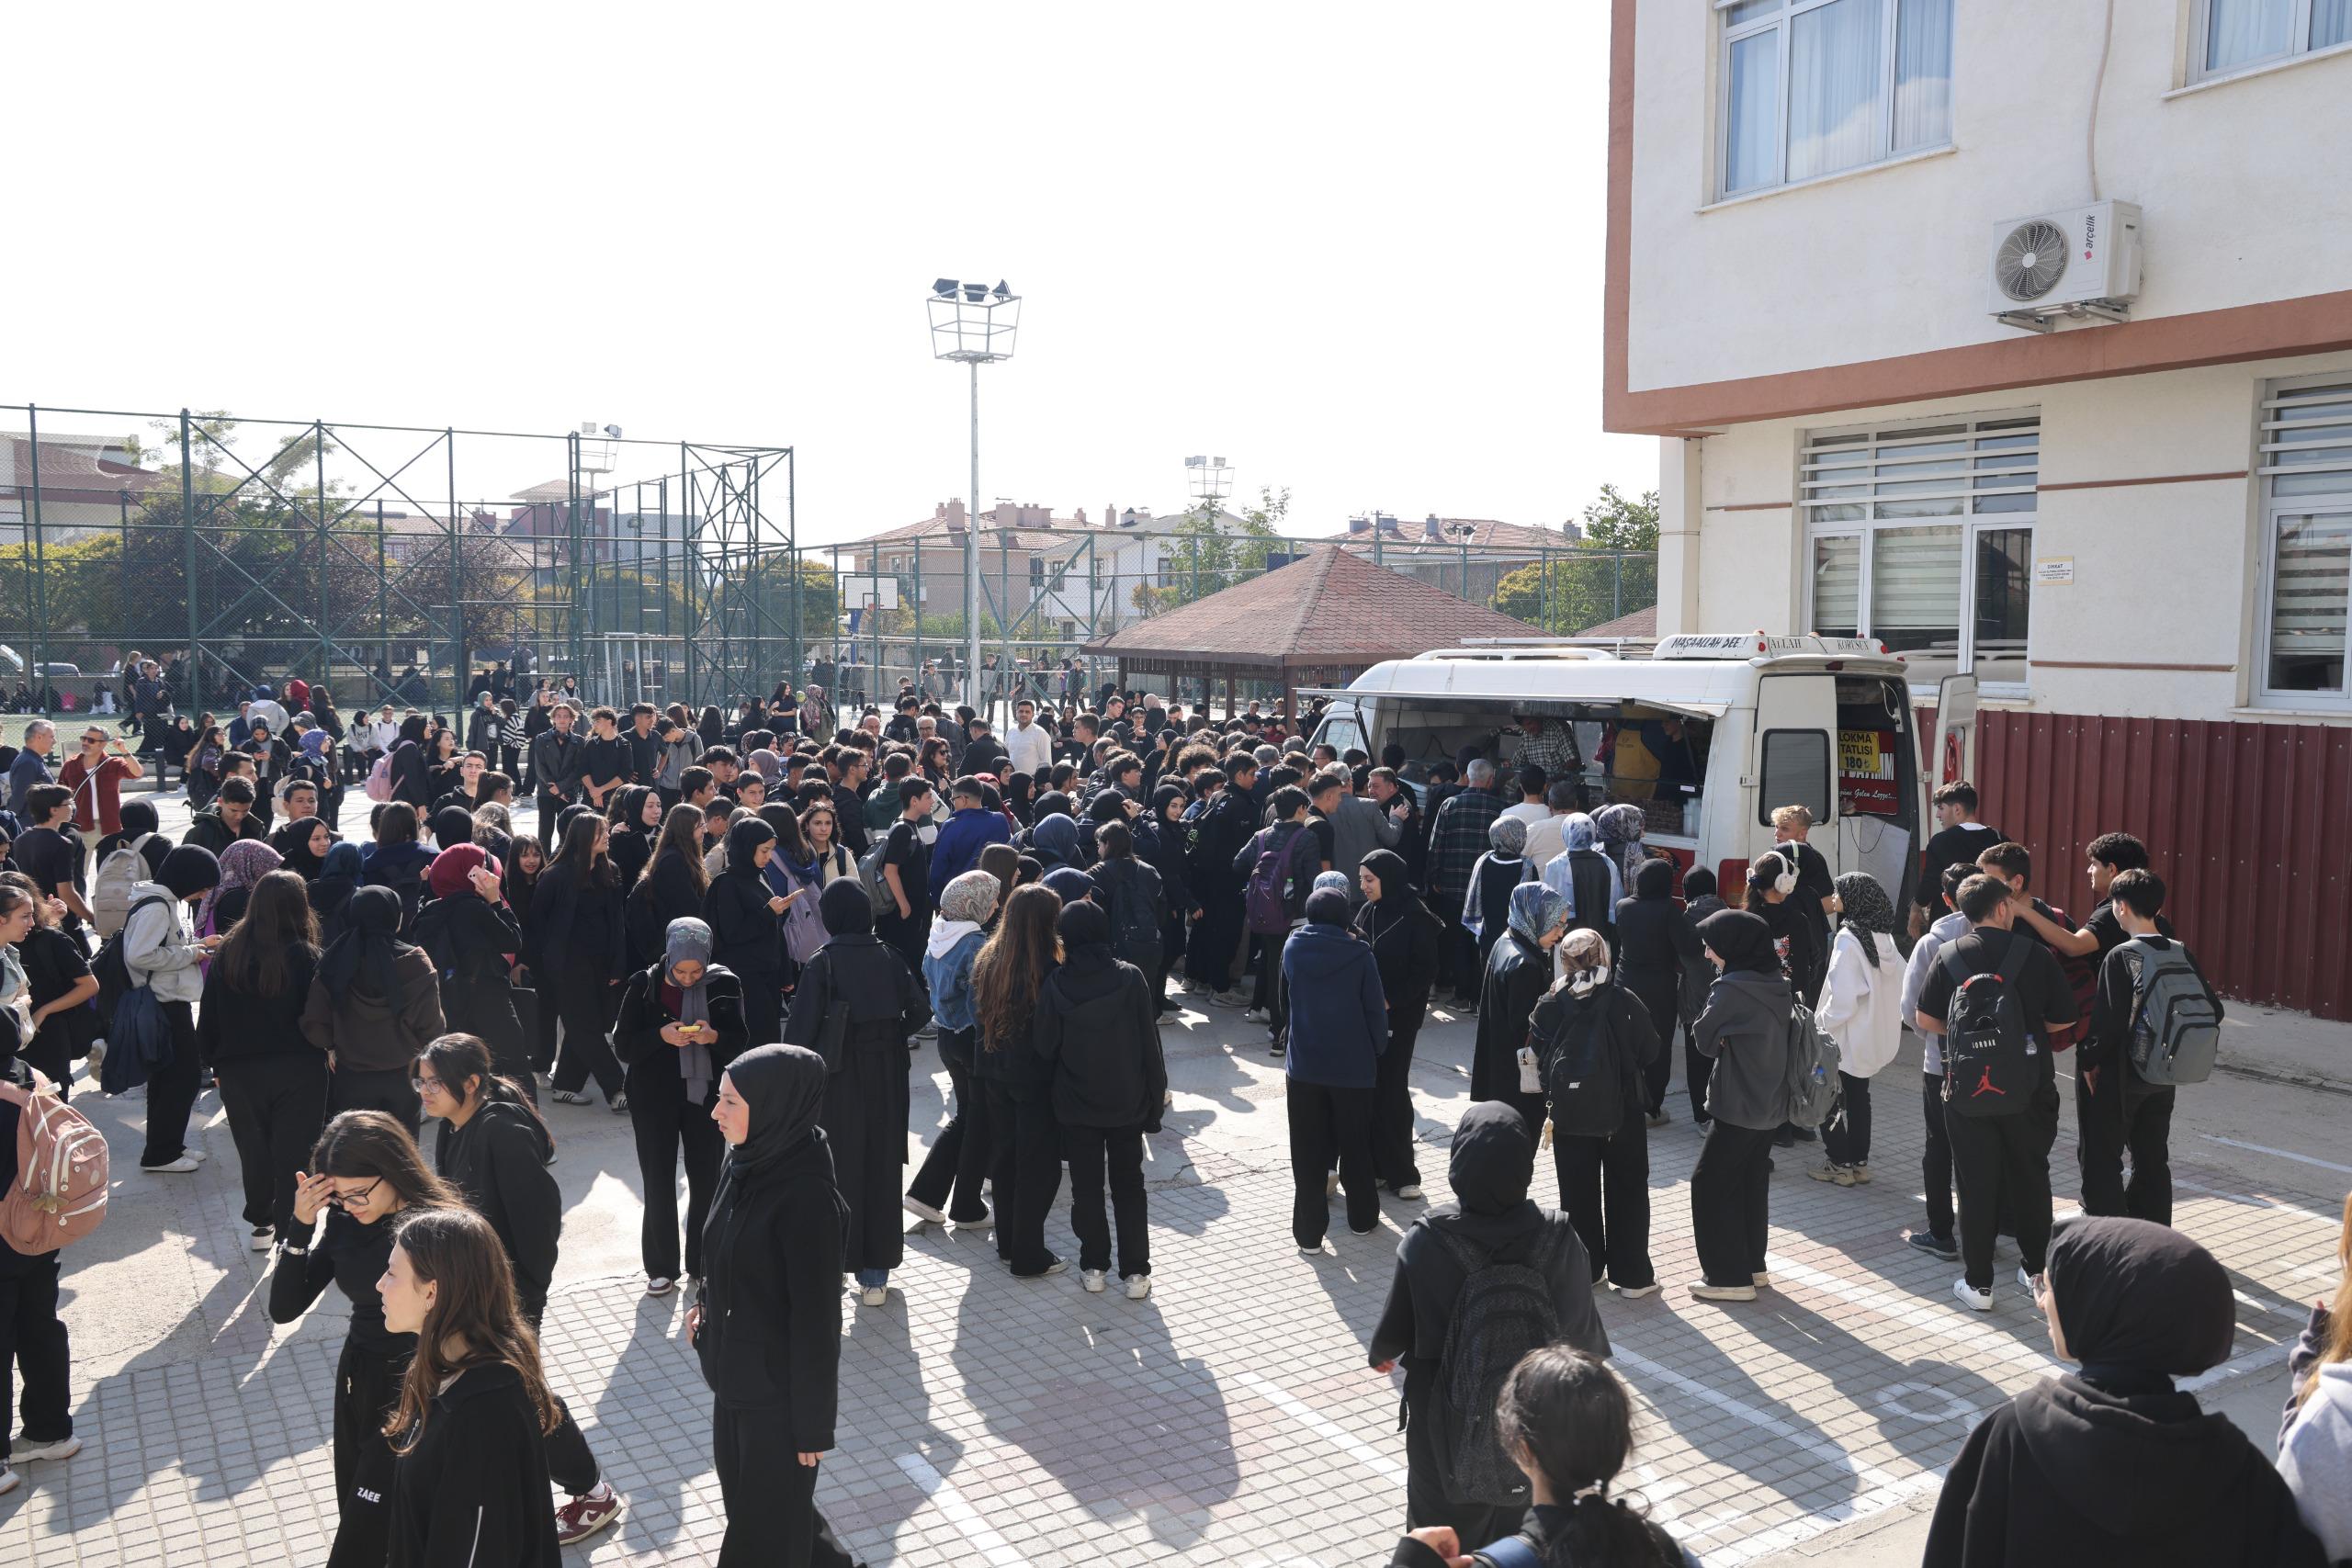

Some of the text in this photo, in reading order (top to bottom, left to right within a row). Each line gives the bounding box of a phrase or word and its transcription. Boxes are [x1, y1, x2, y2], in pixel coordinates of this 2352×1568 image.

[2086, 213, 2096, 249] arçelik
[1770, 638, 1869, 650] ALLAH KORUSUN
[1838, 733, 1872, 744] LOKMA
[1840, 744, 1872, 755] TATLISI
[356, 1486, 381, 1504] ZAEE
